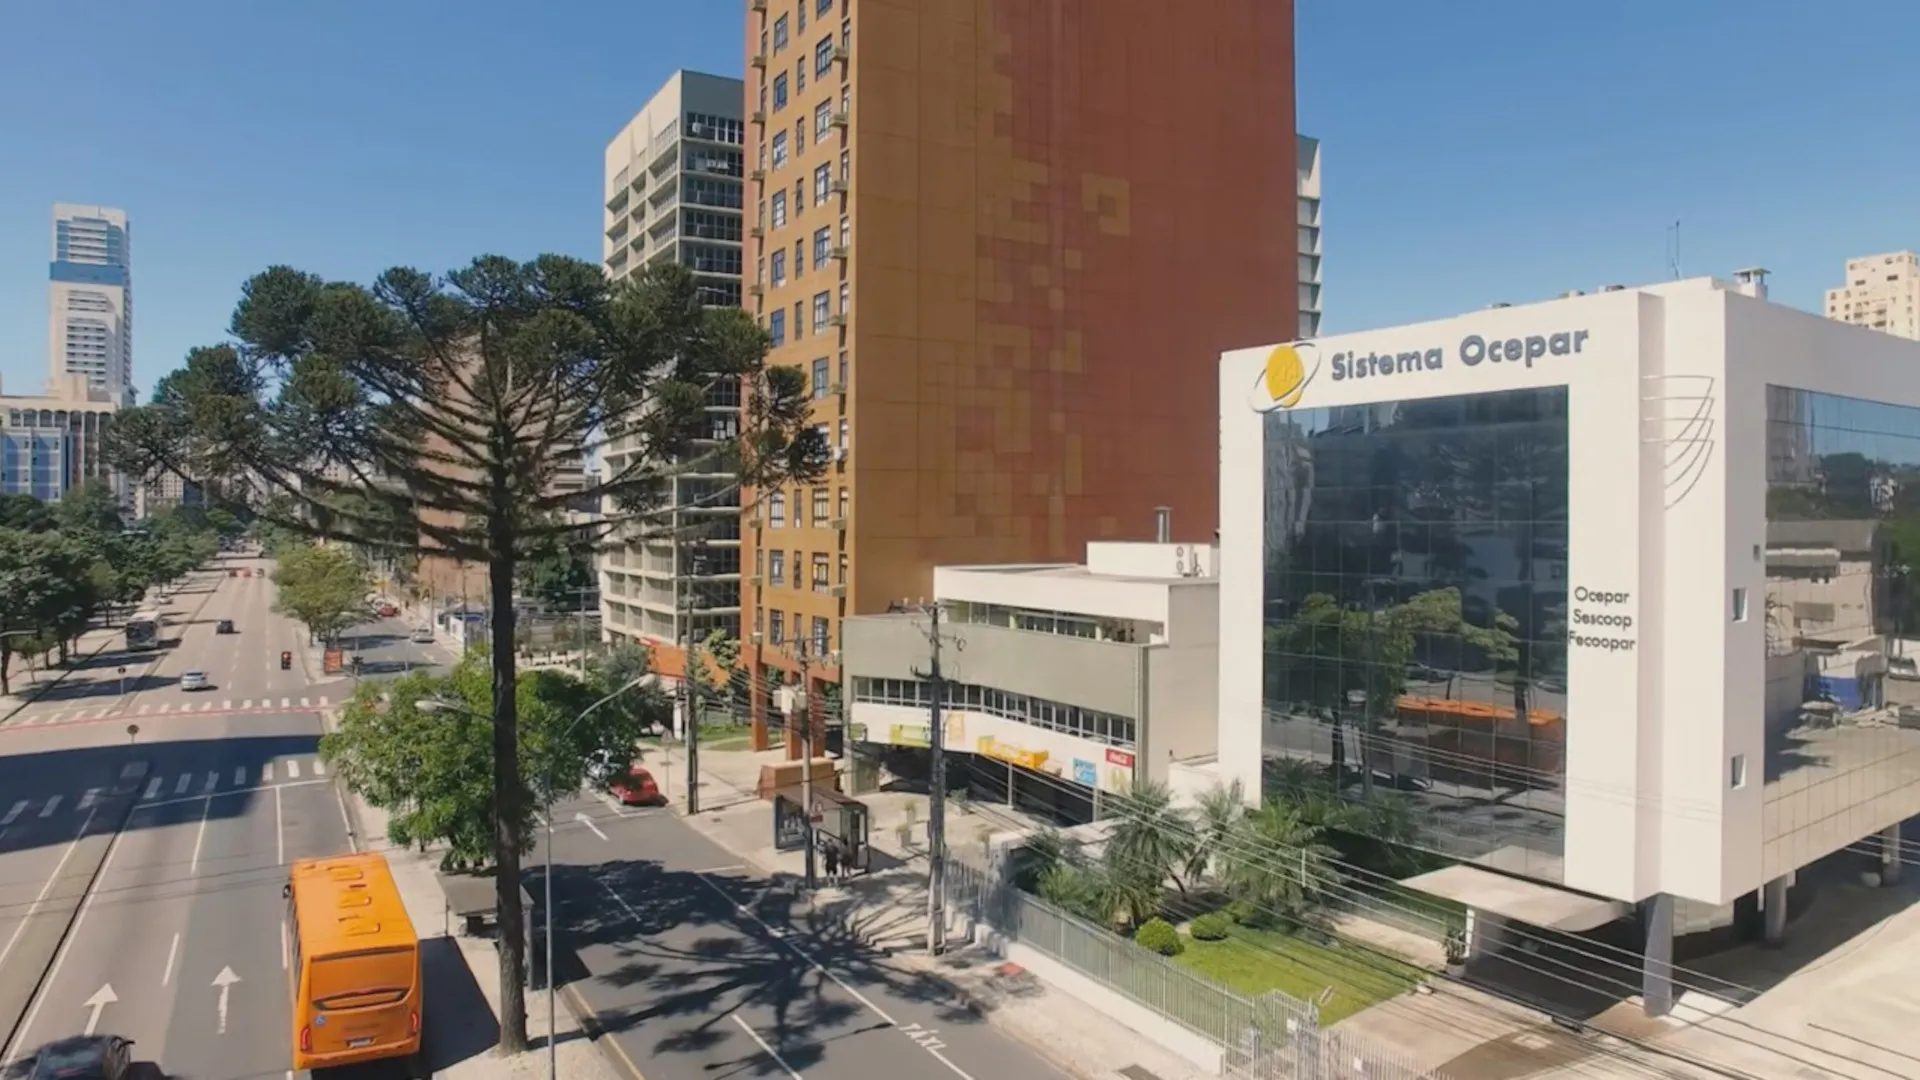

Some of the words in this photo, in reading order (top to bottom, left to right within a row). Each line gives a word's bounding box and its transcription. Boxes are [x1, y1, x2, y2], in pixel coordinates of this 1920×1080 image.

[1331, 348, 1443, 381] Sistema
[1459, 329, 1589, 368] Ocepar
[1574, 585, 1630, 607] Ocepar
[1572, 608, 1632, 632] Sescoop
[1568, 630, 1636, 653] Fecoopar
